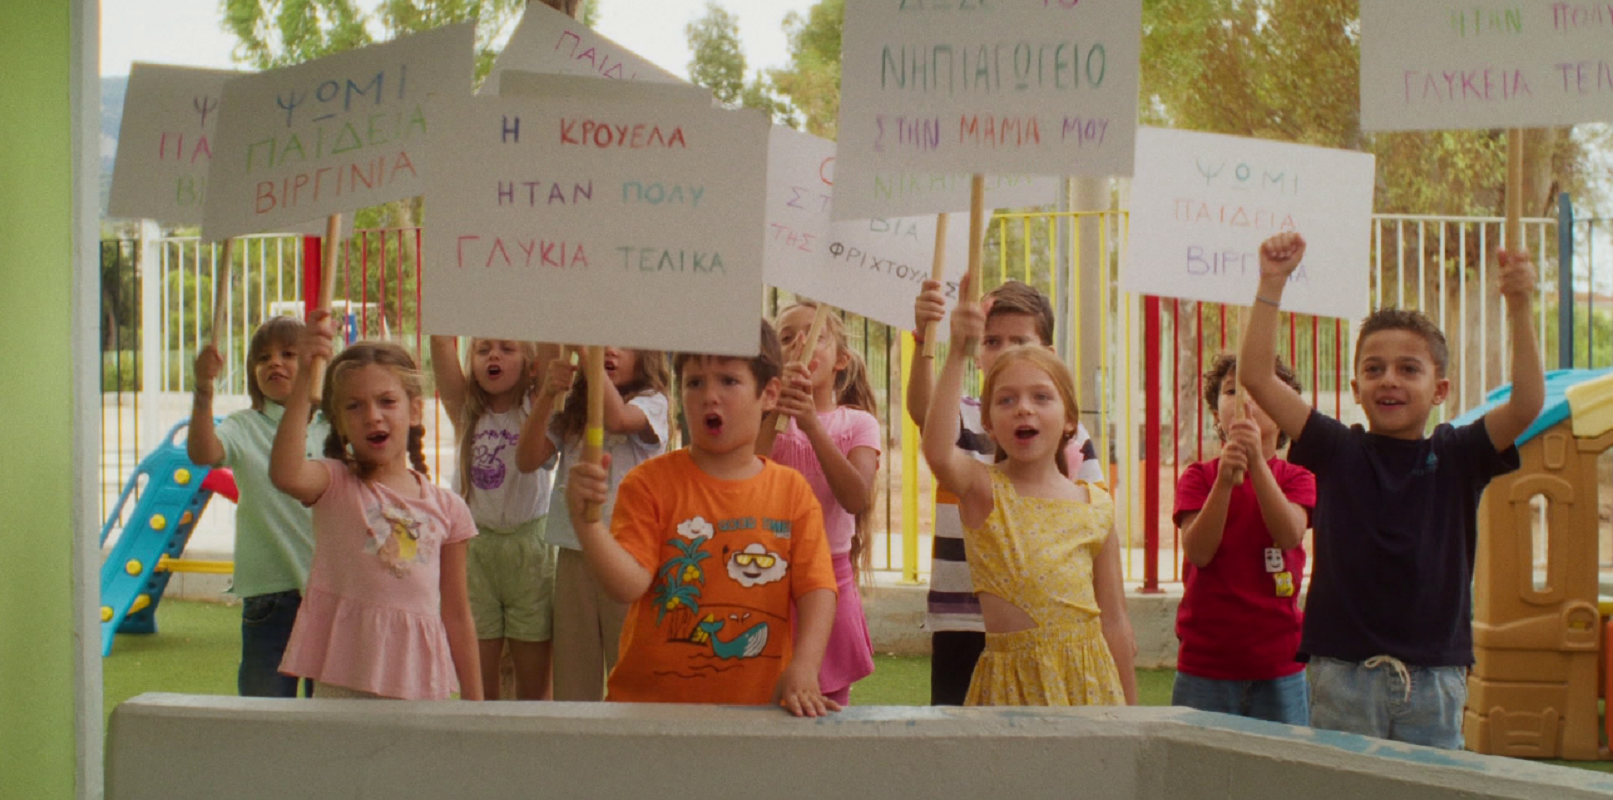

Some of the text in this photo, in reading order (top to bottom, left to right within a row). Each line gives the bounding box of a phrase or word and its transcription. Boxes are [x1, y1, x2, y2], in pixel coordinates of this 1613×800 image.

[554, 29, 638, 80] ΠΑΙΔ
[1405, 59, 1613, 102] ΓΛΥΚΕΙΑ ΤΕΛ
[245, 104, 428, 173] ΠΑΙΔΕΙΑ
[502, 114, 687, 149] Η ΚΡΟΥΕΛΑ
[873, 113, 1109, 152] ΣΤΗΝ ΜΑΜΑ ΜΟΥ
[254, 151, 417, 215] ΒΙΡΓΙΝΙΑ
[497, 179, 704, 207] ΗΤΑΝ ΠΟΛΥ
[456, 235, 726, 274] ΓΛΥΚΙΑ ΤΕΛΙΚΑ
[770, 222, 960, 301] ΤΗΣ ΦΡΙΧΤΟΥΛΣ
[1187, 246, 1308, 283] ΒΙΡΓΑ
